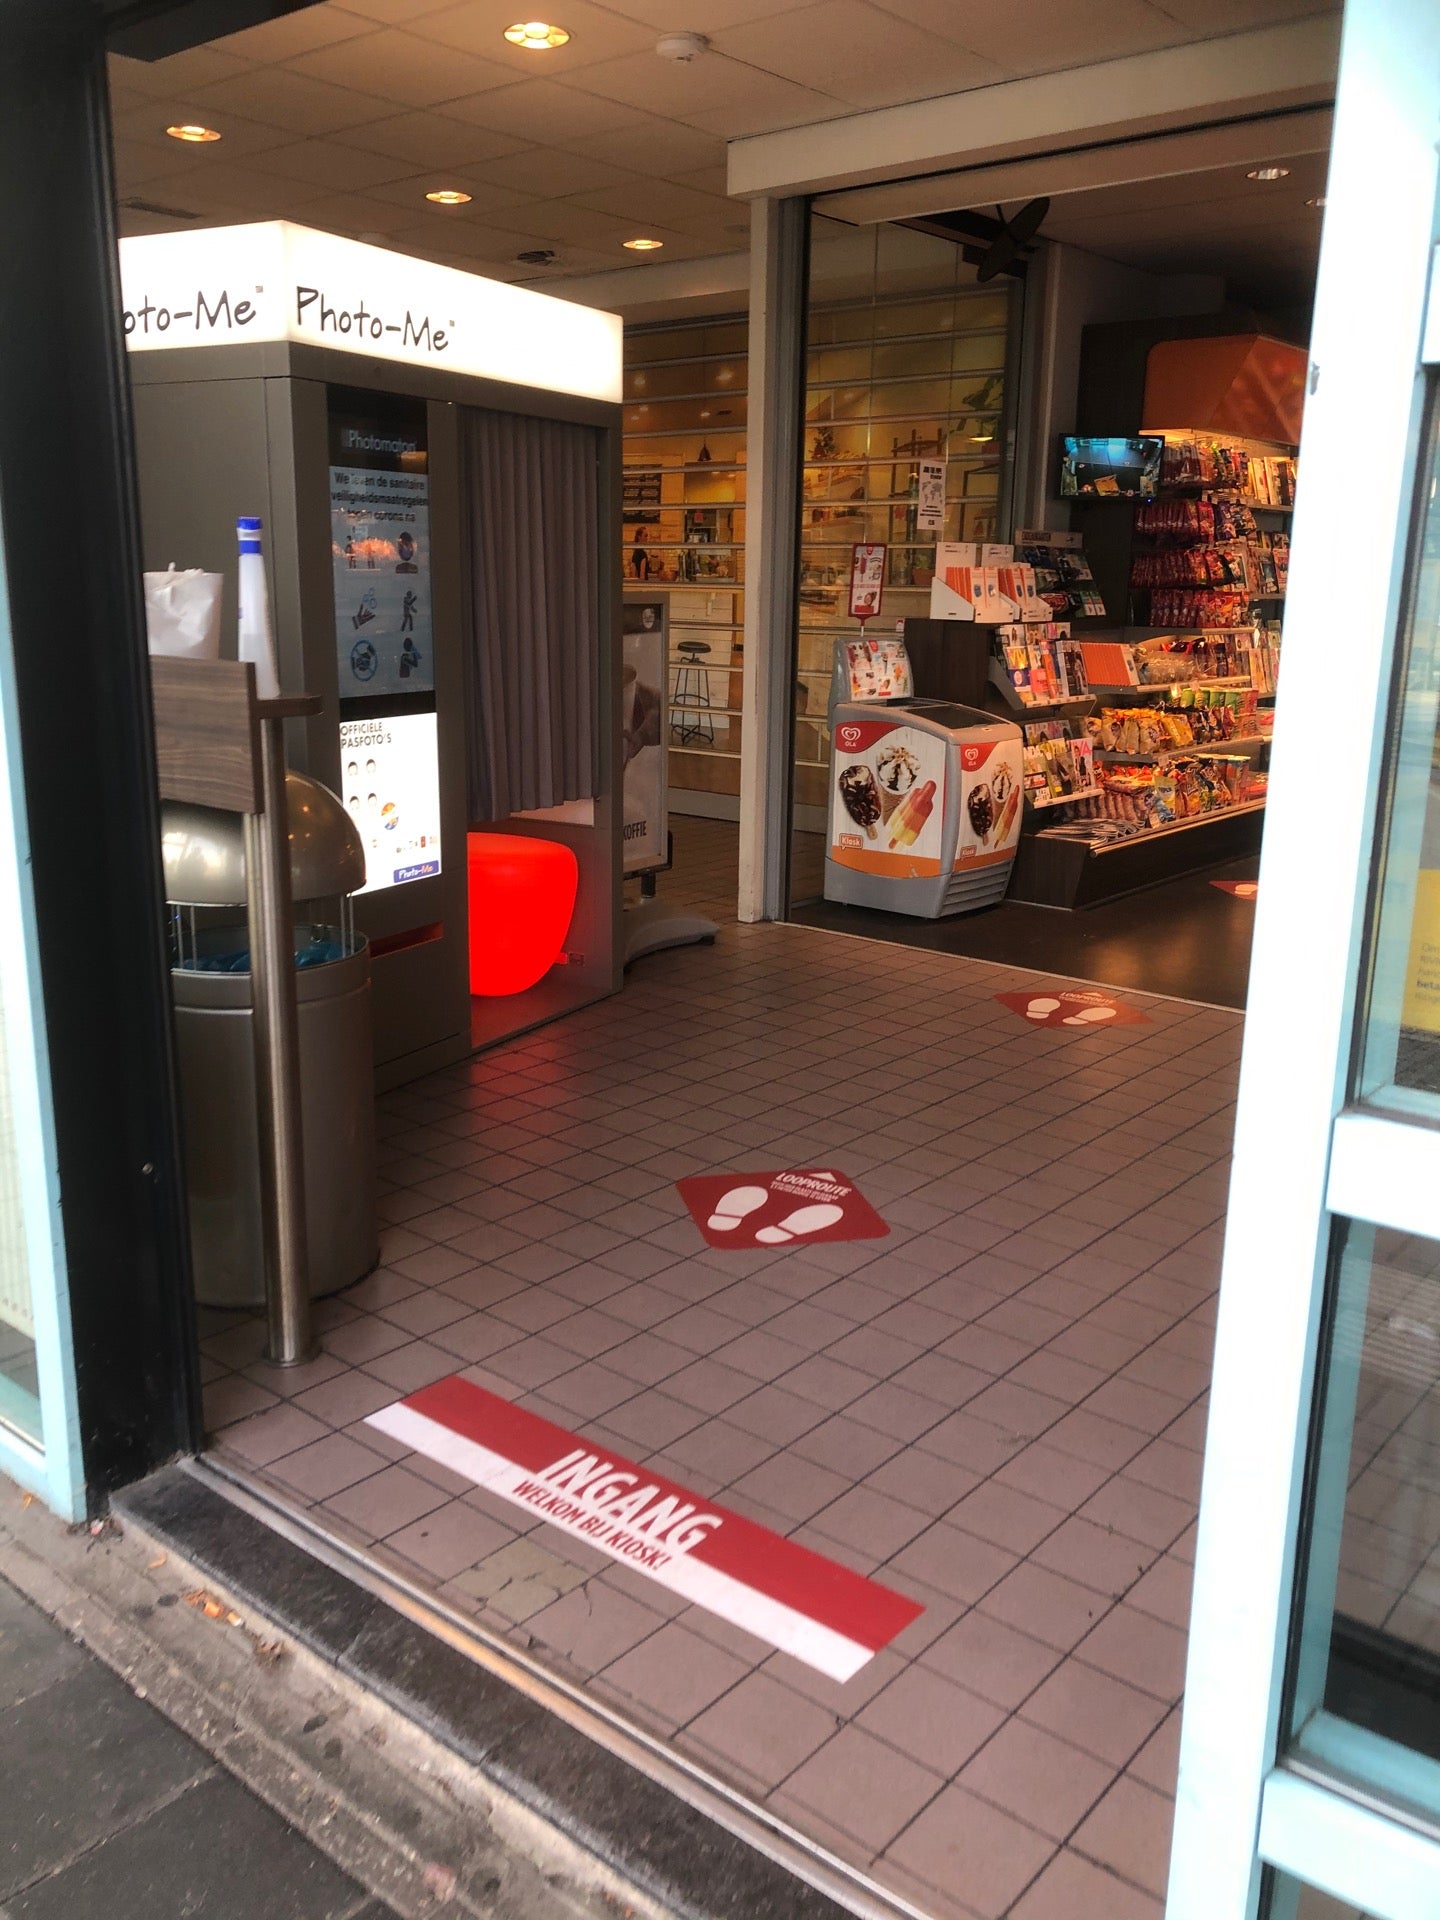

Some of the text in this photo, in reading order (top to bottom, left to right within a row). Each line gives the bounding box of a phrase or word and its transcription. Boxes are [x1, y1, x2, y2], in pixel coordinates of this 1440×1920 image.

[296, 285, 449, 352] Photo-Me
[334, 472, 350, 484] We
[376, 476, 387, 487] de
[340, 722, 383, 736] OFFICIELE
[341, 732, 392, 749] PASFOTO'S
[841, 836, 861, 846] Kiosk
[398, 863, 434, 880] Photo-Me
[775, 1172, 852, 1197] LOOPROUTE
[536, 1448, 724, 1556] INGANG
[512, 1480, 673, 1571] WELKOM BIJ KIOSK!
